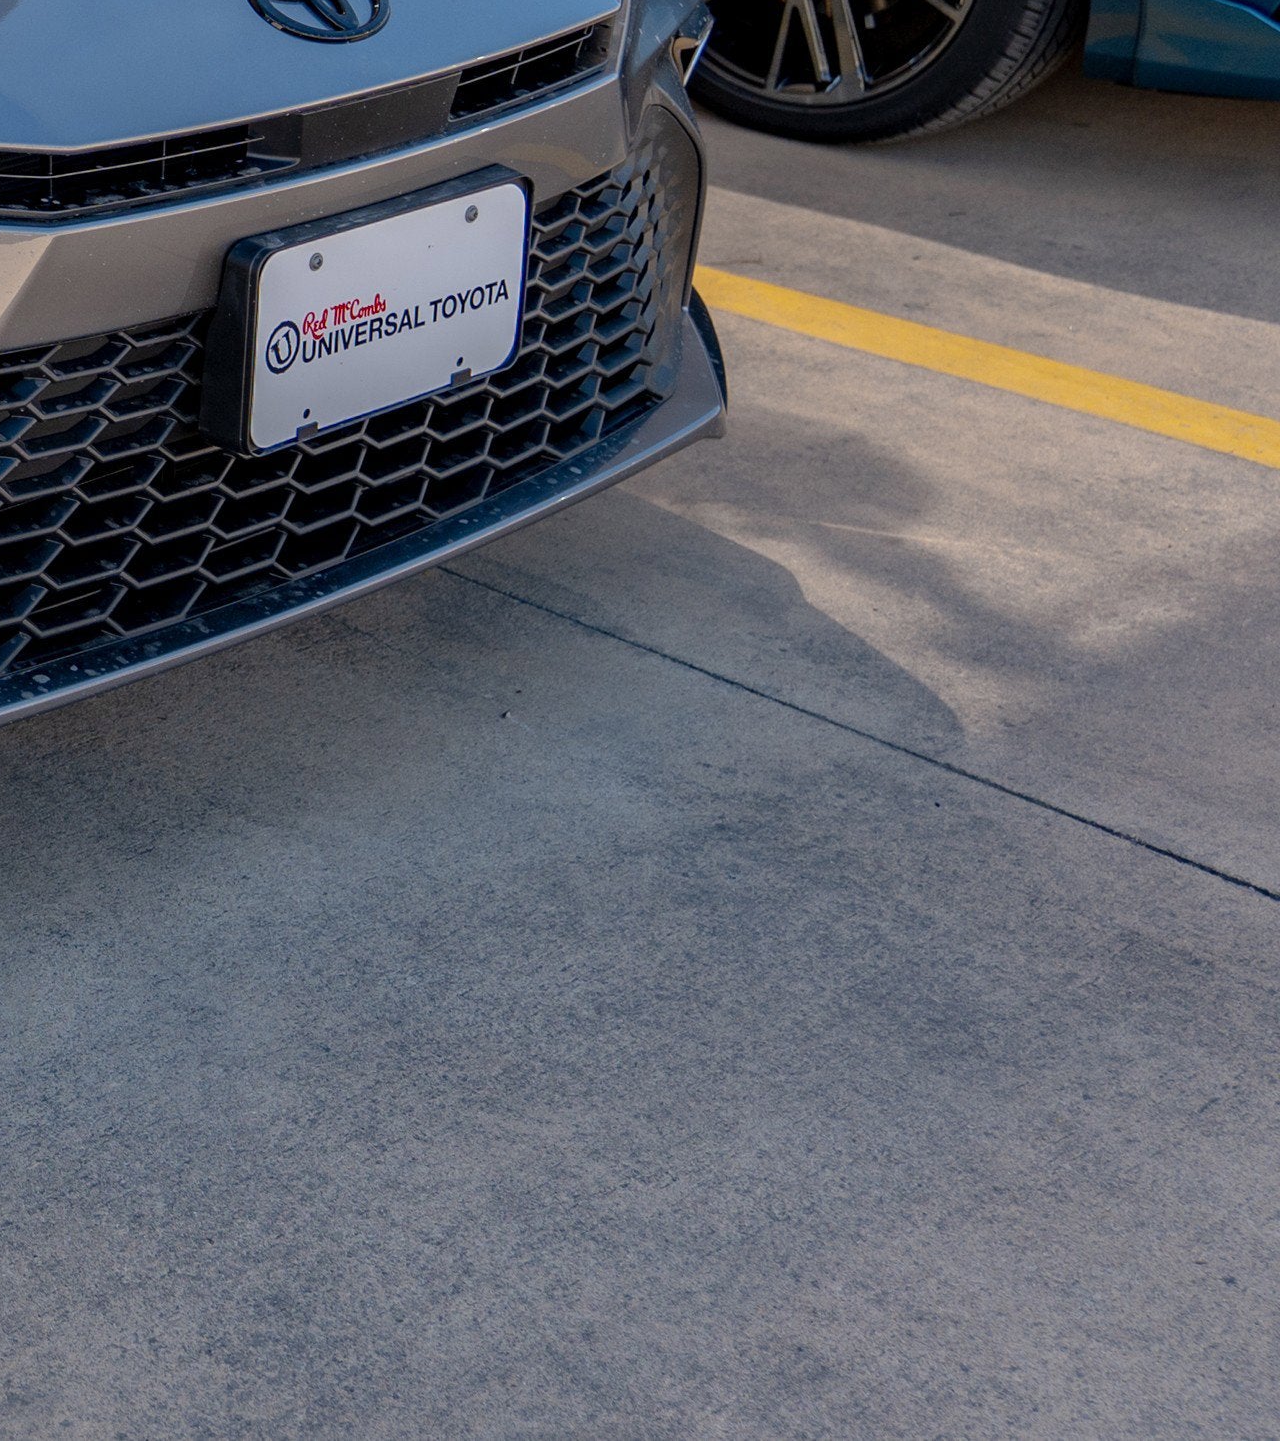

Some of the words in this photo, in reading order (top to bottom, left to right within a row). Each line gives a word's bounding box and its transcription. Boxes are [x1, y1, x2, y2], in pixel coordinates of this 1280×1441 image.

[302, 306, 426, 363] UNIVERSAL
[429, 279, 509, 322] TOYOTA
[303, 310, 328, 340] Red
[330, 293, 387, 326] McCombs
